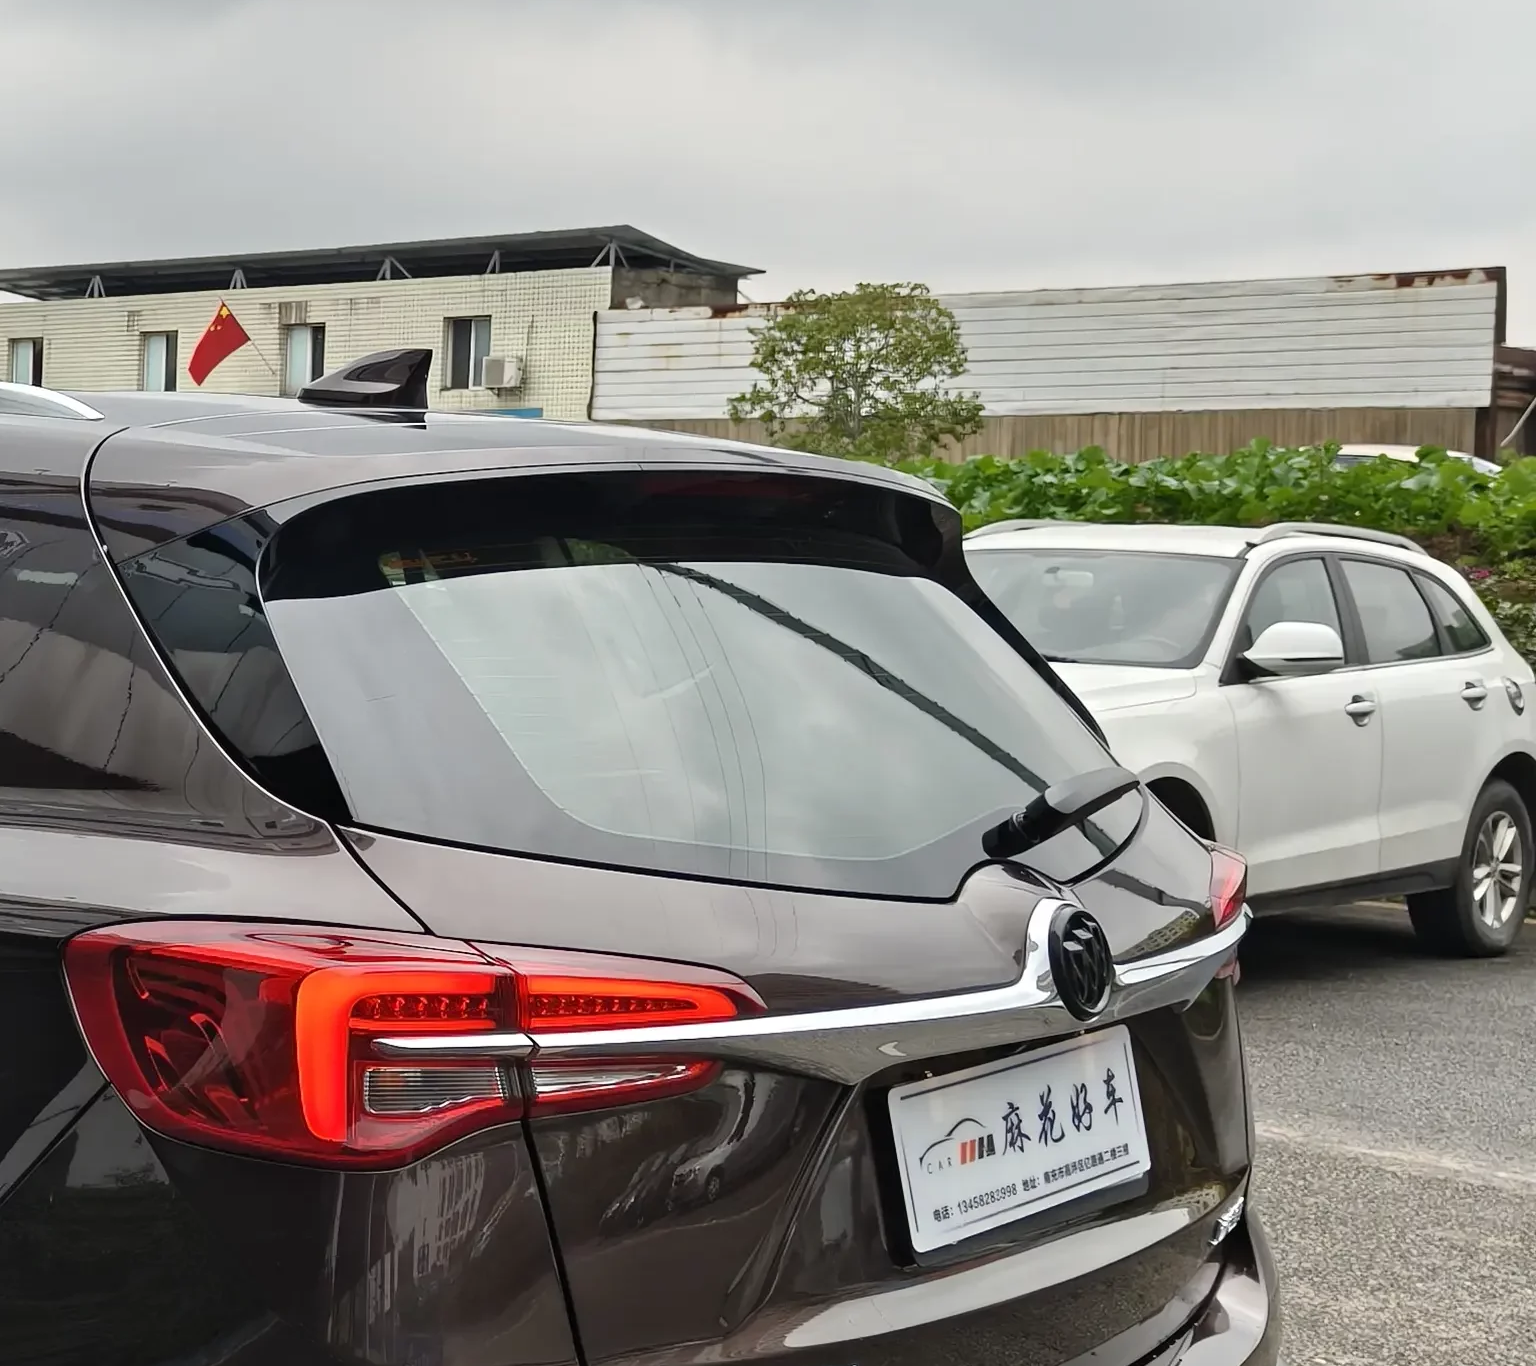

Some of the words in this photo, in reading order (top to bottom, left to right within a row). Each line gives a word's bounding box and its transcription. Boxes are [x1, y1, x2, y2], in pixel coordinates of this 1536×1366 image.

[1002, 1068, 1123, 1155] 麻花好车
[927, 1157, 952, 1174] CAR
